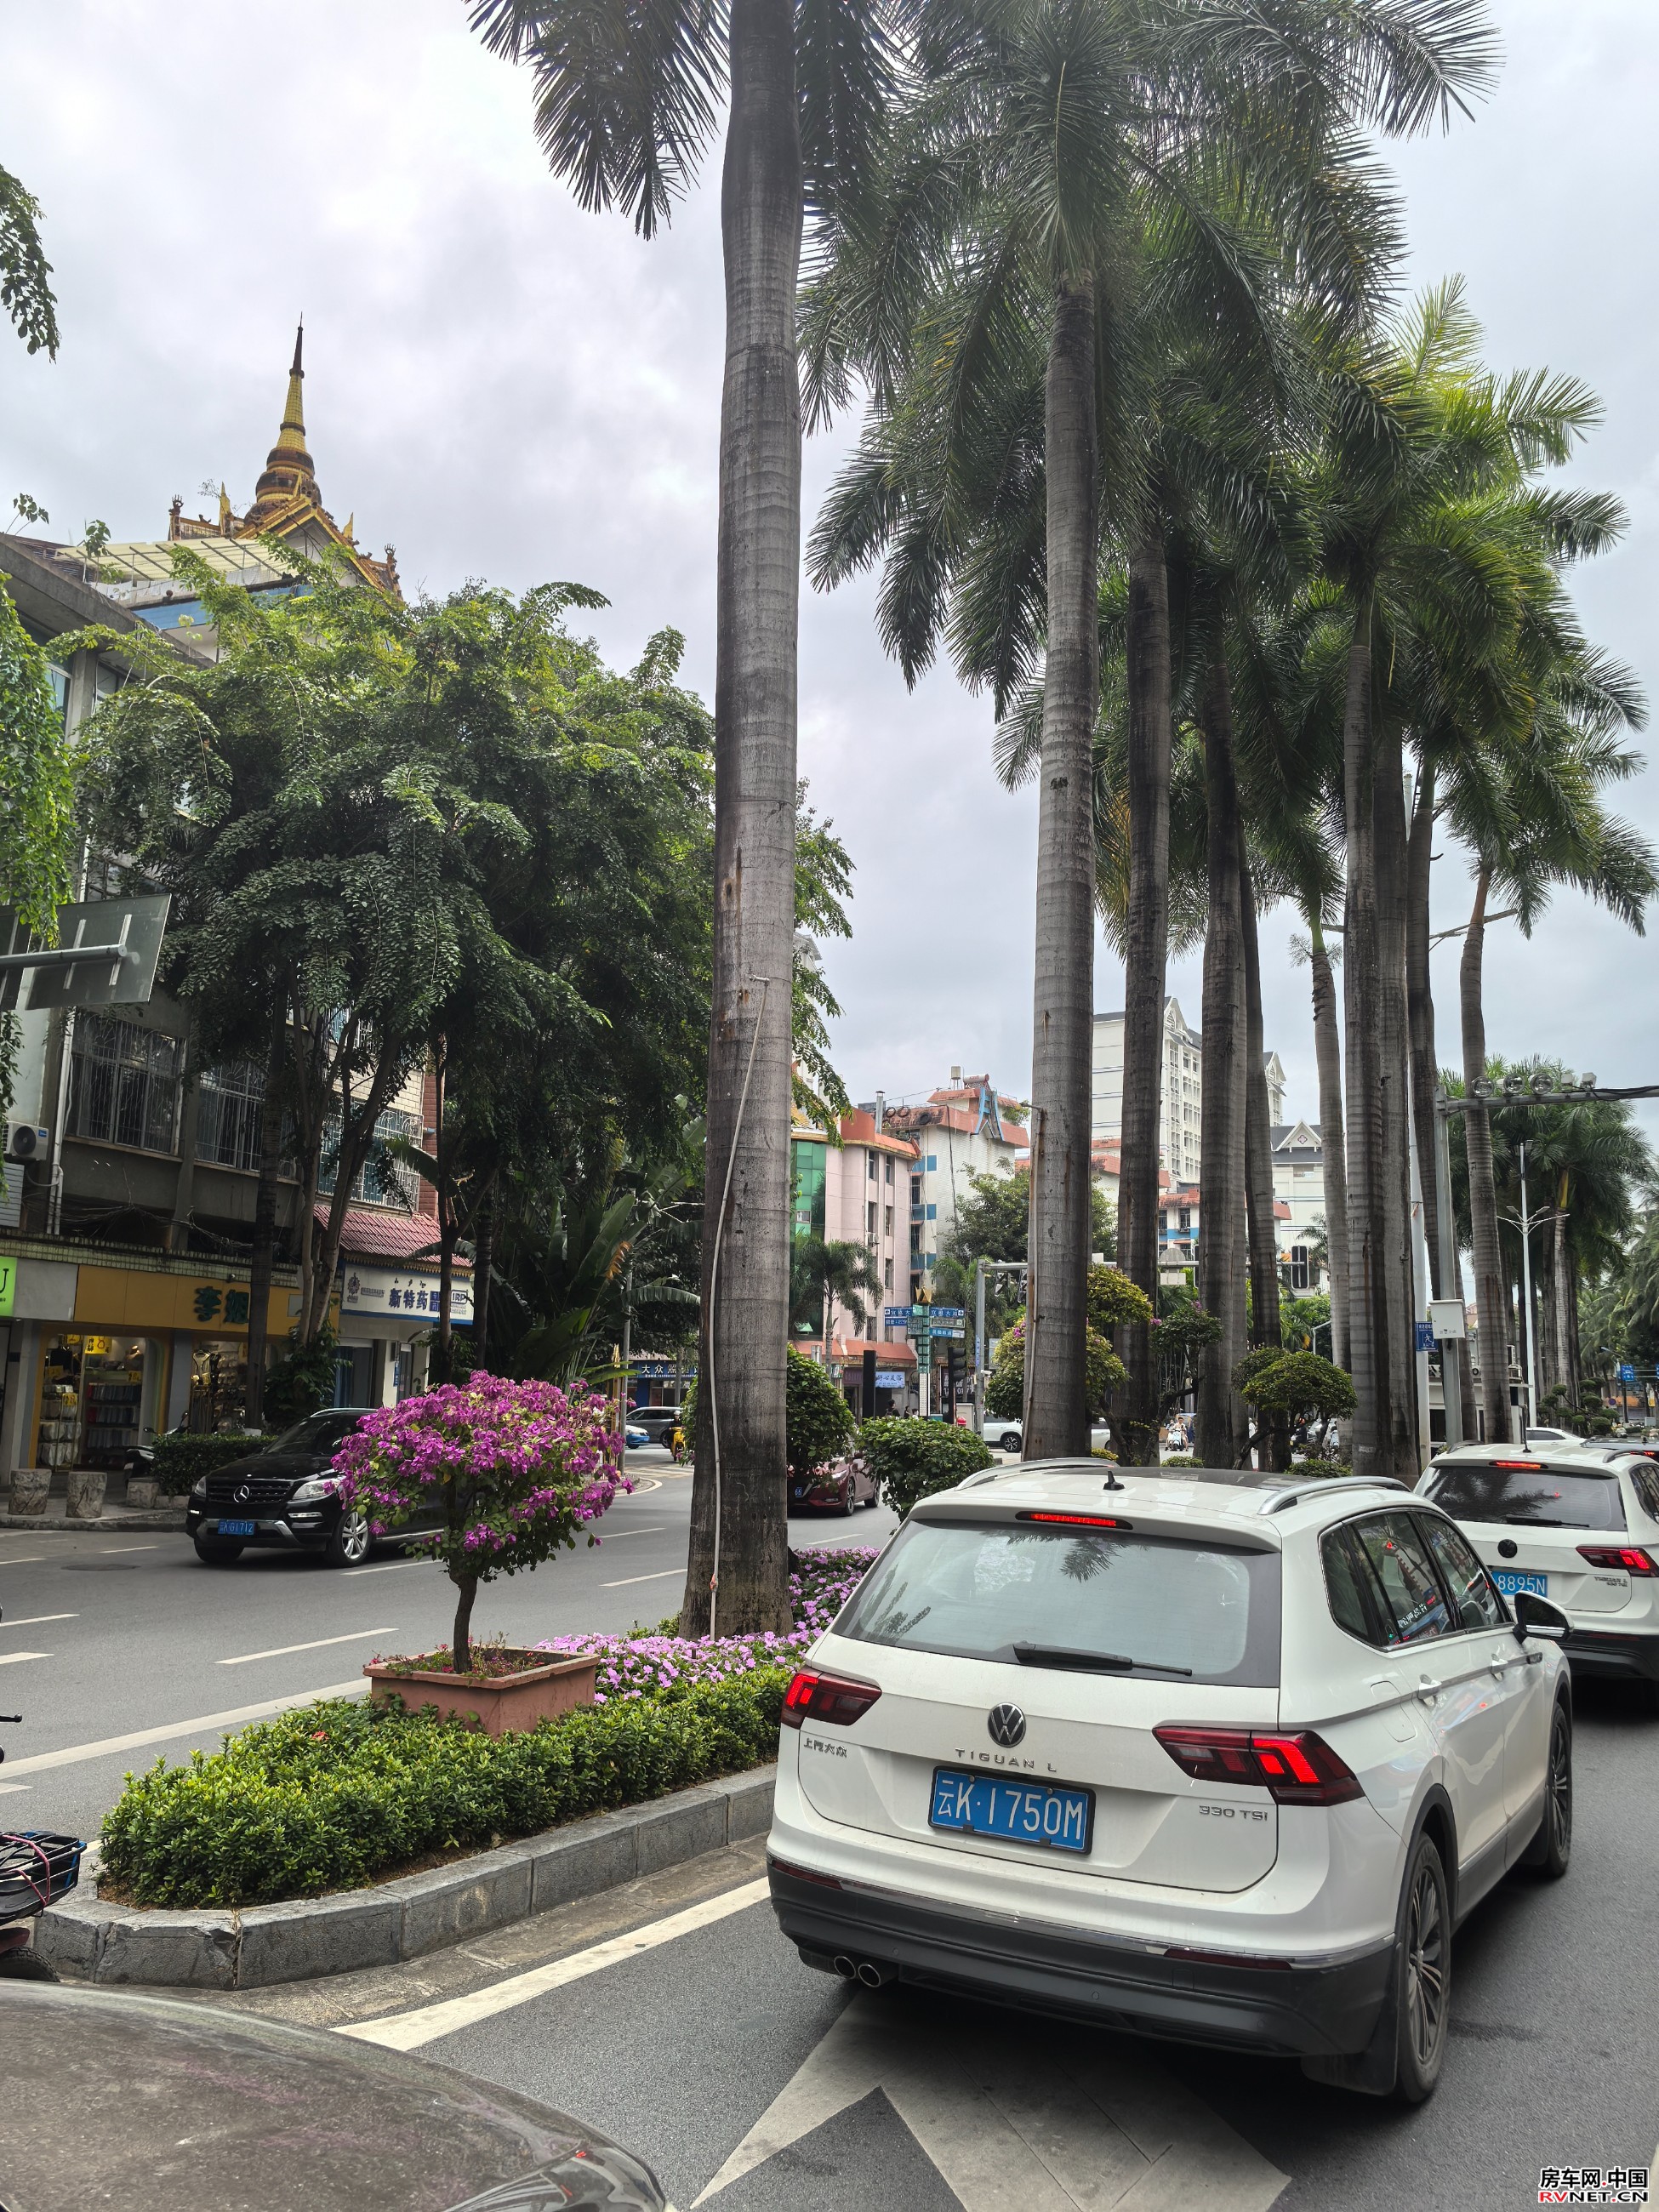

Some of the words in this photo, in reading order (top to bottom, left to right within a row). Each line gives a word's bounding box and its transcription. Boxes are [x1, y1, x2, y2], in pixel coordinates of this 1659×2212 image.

[389, 1288, 428, 1310] 新特药
[803, 1737, 847, 1758] 上汽大众
[955, 1747, 1035, 1770] TIGUAN
[1047, 1762, 1058, 1773] L
[1199, 1805, 1235, 1818] 330
[1239, 1809, 1268, 1821] TSI
